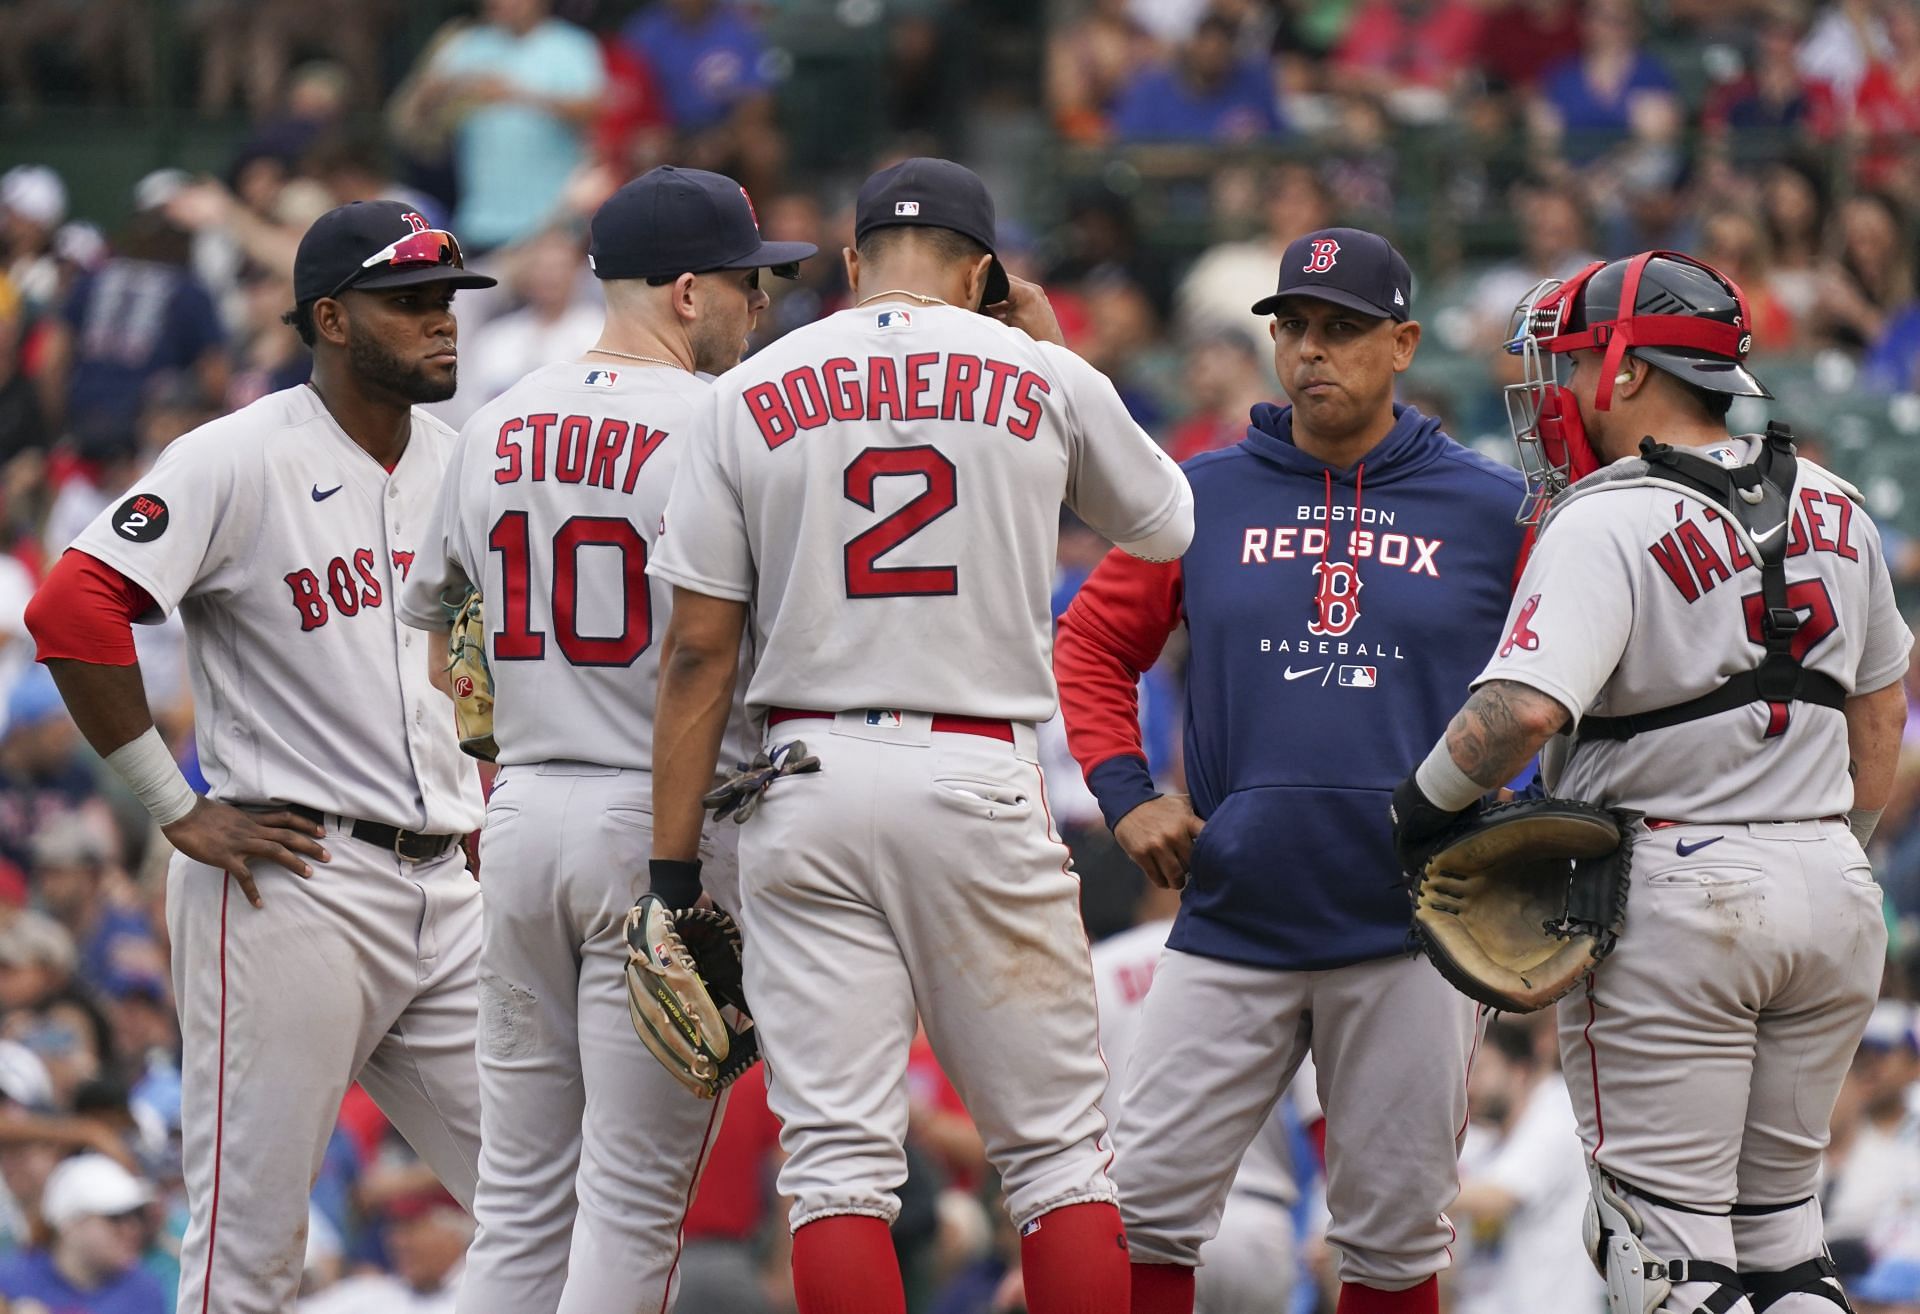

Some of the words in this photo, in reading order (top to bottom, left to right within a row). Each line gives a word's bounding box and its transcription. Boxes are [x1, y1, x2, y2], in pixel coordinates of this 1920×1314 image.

[1303, 238, 1341, 273] B
[742, 352, 1051, 450] BOGAERTS
[494, 412, 670, 495] STORY
[120, 512, 148, 537] 2
[132, 496, 165, 520] REMY
[843, 444, 958, 599] 2
[1297, 505, 1395, 526] BOSTON
[1241, 527, 1330, 564] RED
[1348, 530, 1444, 578] SOX
[1648, 487, 1859, 605] VÁZEZ
[489, 510, 652, 668] 10
[1307, 561, 1364, 637] B
[1260, 639, 1404, 660] BASEBALL
